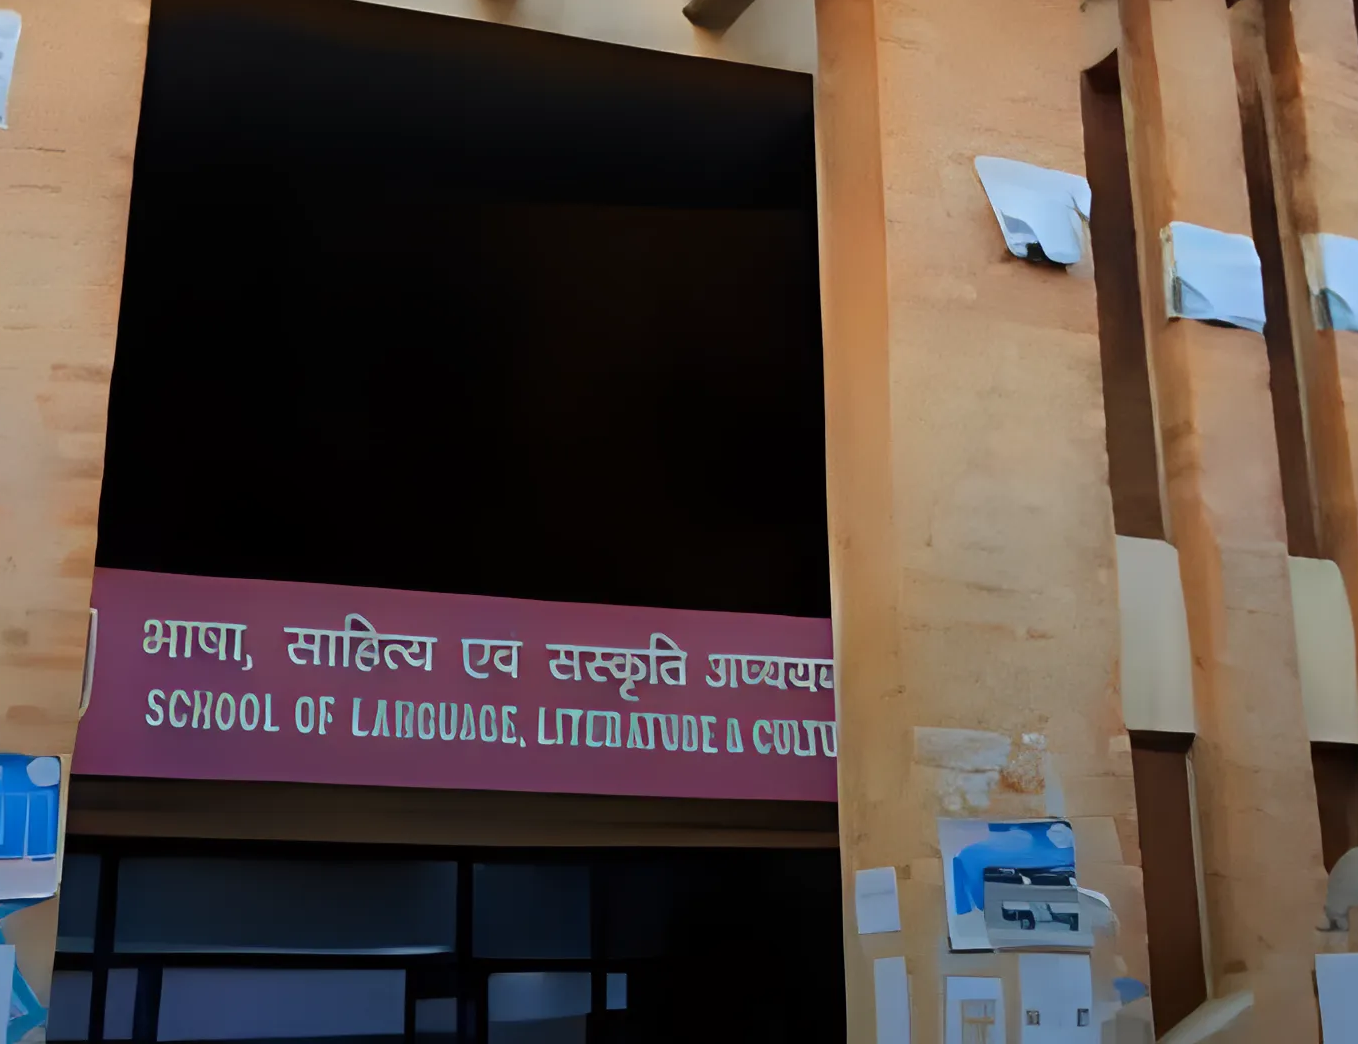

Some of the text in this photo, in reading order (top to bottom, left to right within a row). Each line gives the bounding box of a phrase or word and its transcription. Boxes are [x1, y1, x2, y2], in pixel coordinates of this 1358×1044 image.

[142, 619, 253, 671] भाषा,
[283, 613, 438, 672] साहित्य
[144, 687, 281, 732] SCHOOL
[294, 695, 336, 736] OF
